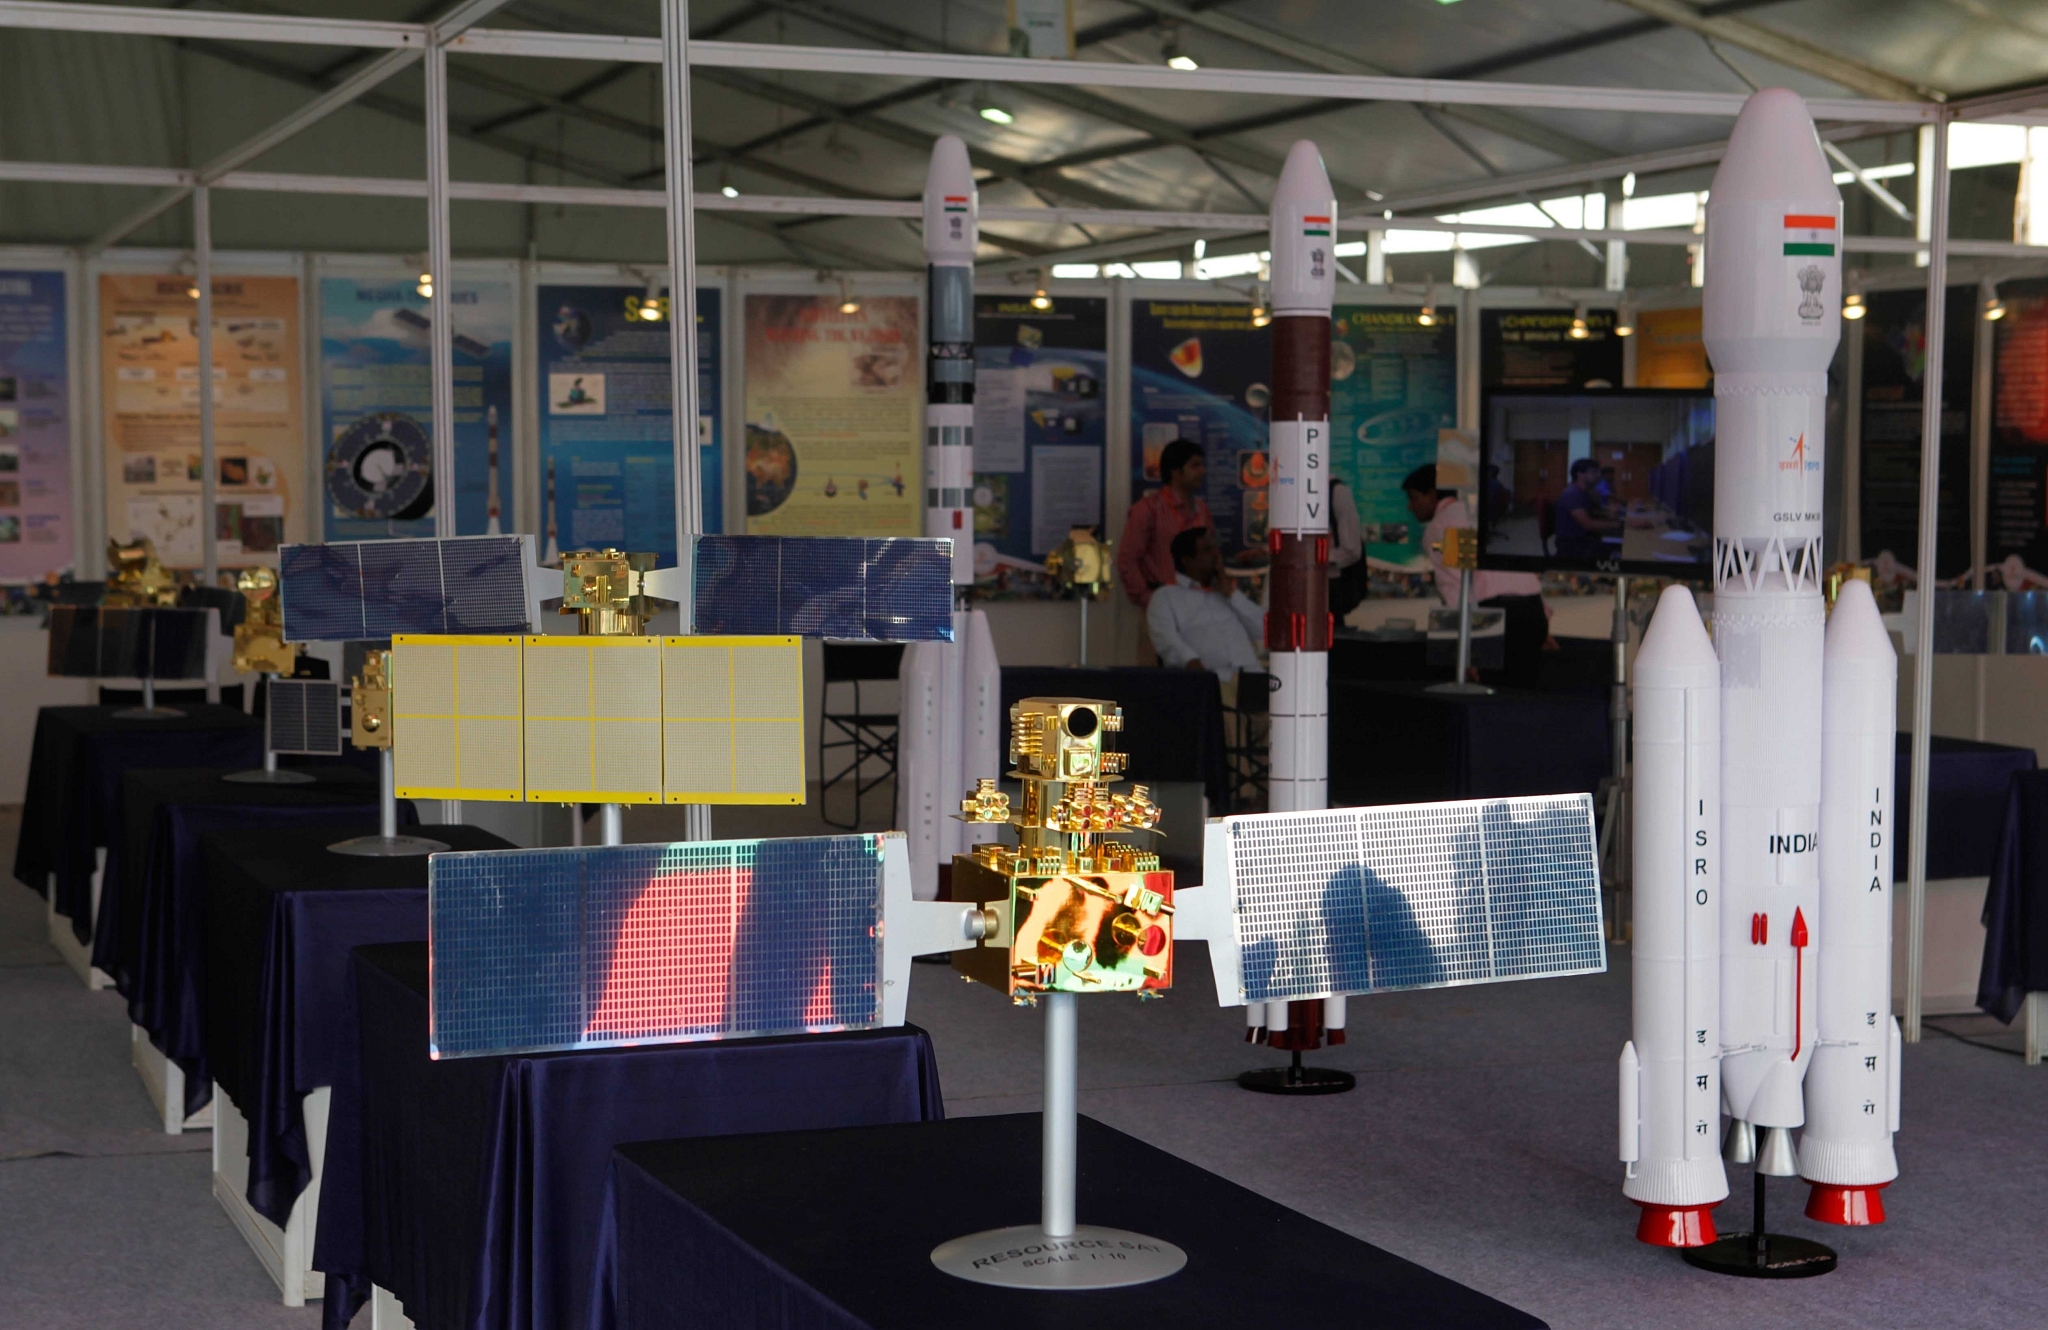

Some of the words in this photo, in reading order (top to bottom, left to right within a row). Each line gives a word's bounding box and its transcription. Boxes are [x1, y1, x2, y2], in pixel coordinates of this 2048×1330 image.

[1306, 428, 1320, 519] PSLV
[1773, 512, 1802, 522] GSLV
[1695, 799, 1708, 905] ISRO
[1869, 787, 1882, 892] INDIA
[972, 1240, 1113, 1269] RESOURCE
[1119, 1241, 1162, 1254] SAT
[1022, 1253, 1080, 1268] SCALE
